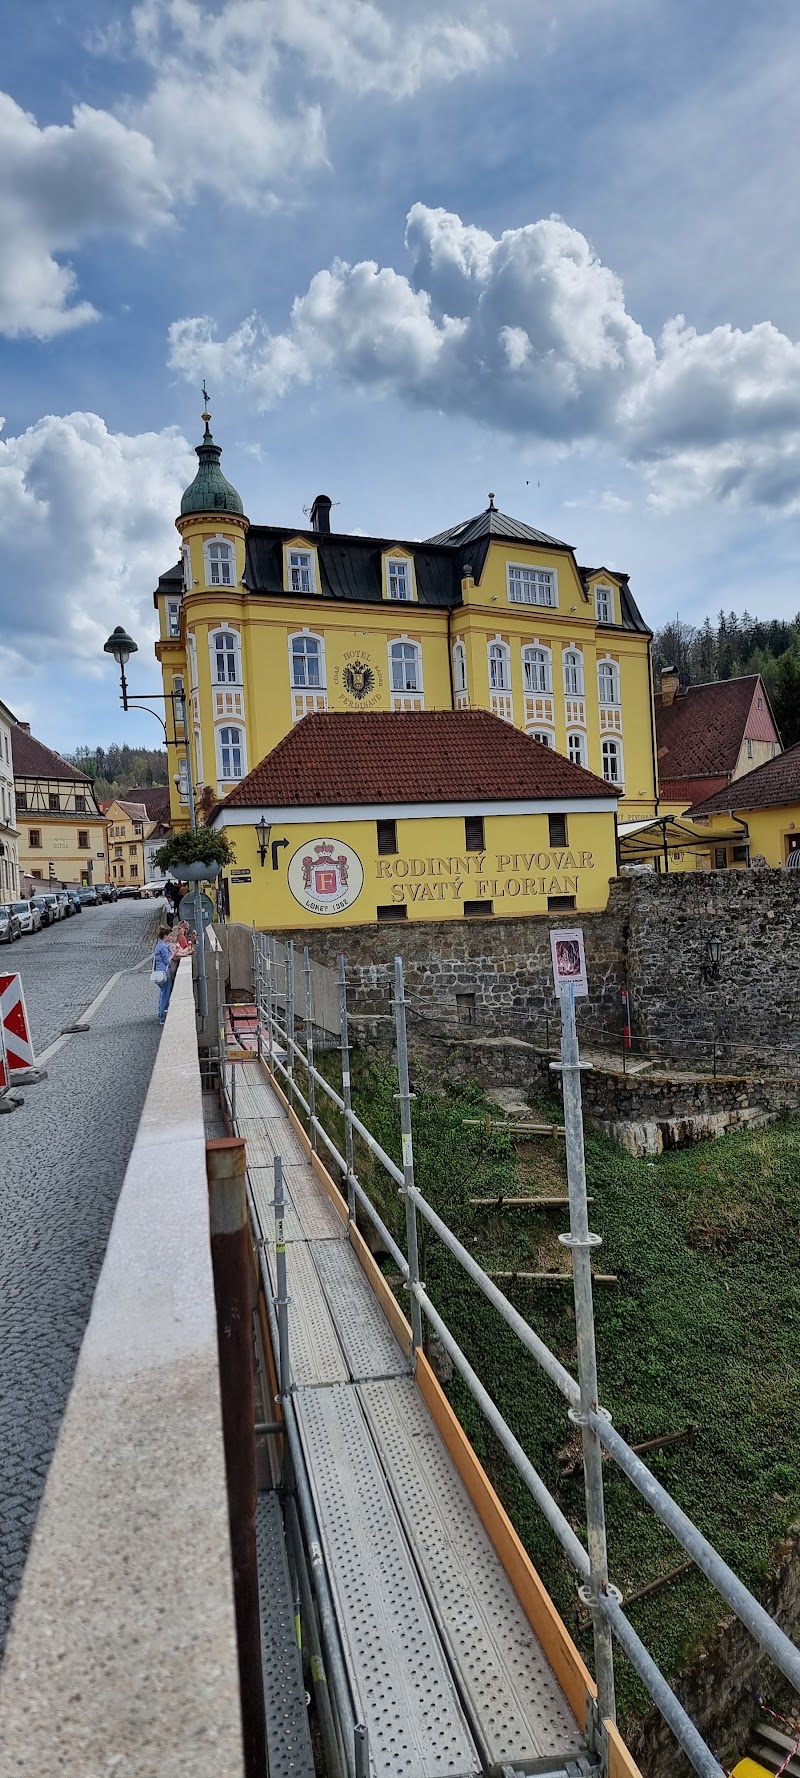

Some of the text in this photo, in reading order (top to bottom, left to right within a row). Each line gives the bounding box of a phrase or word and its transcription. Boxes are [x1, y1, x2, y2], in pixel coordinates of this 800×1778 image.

[343, 650, 371, 662] HOTEL
[338, 693, 382, 709] FERDINAND
[375, 850, 595, 879] RODINNÝ PIVOVAR
[317, 873, 333, 891] F
[391, 875, 580, 903] SVATÝ FLORIAN
[305, 900, 329, 912] LOKET
